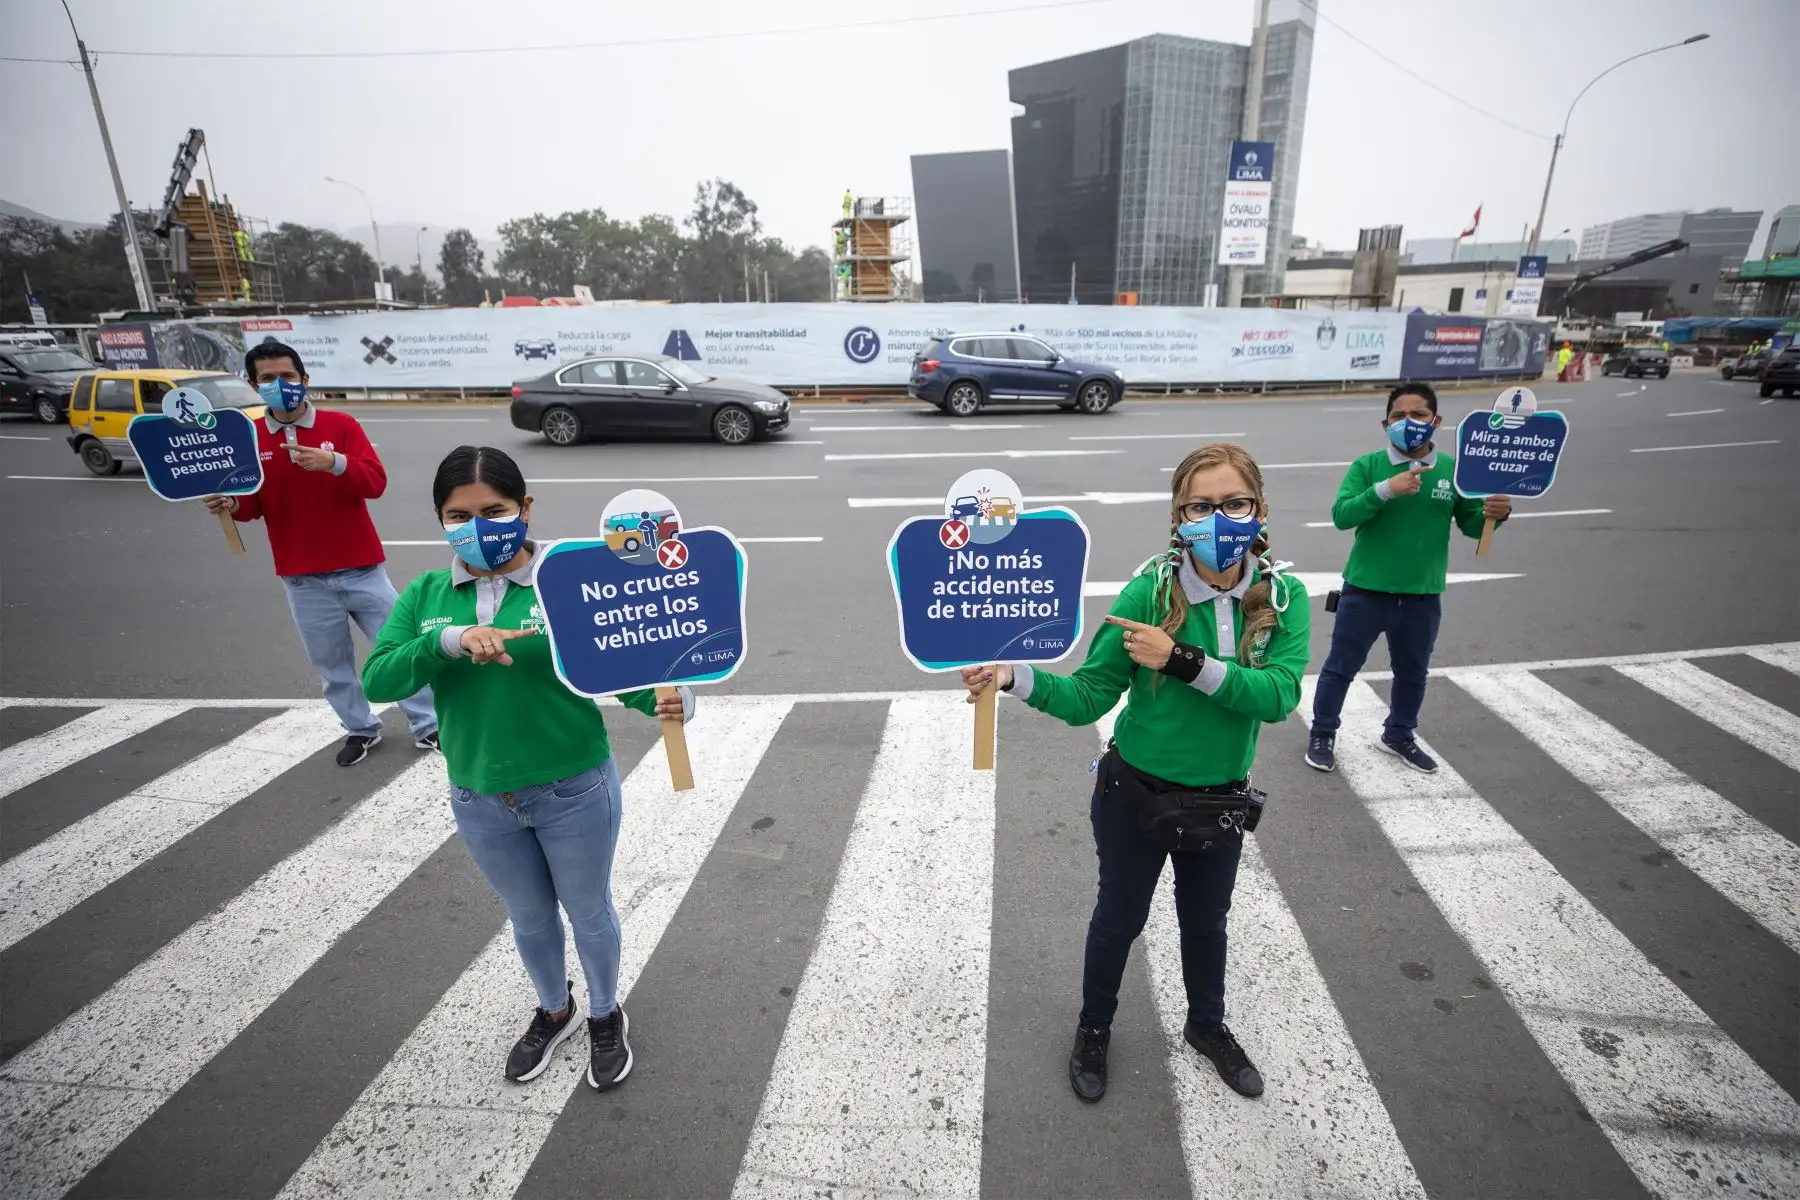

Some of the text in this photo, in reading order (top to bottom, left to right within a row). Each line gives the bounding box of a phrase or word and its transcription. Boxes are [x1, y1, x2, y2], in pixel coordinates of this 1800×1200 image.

[1236, 170, 1263, 180] LIMA
[1224, 218, 1268, 228] MONITOR
[427, 333, 437, 342] de
[557, 330, 595, 340] Reducirá
[606, 332, 631, 340] carga
[705, 328, 807, 340] Mejor transitabilidad
[888, 328, 920, 337] Ahorro
[922, 328, 935, 337] de
[1045, 328, 1063, 338] Más
[1066, 329, 1076, 338] de
[1078, 330, 1094, 338] 500
[1096, 328, 1109, 337] mil
[1112, 329, 1142, 338] vecinos
[1144, 329, 1154, 338] de
[734, 342, 776, 352] avenidas
[1083, 342, 1094, 350] de
[1096, 342, 1118, 350] Surco
[1345, 332, 1386, 350] LIMA
[120, 348, 148, 360] MONITOR
[559, 344, 612, 352] vehicular del
[1123, 354, 1138, 362] San
[168, 432, 218, 448] Utiliza
[1470, 430, 1556, 448] Mira a ambos
[164, 445, 234, 464] el crucero
[1464, 444, 1555, 462] lados antes de
[170, 456, 236, 480] peatonal
[1488, 462, 1529, 473] cruzar
[948, 549, 1043, 574] ¡No más
[581, 570, 700, 602] No cruces
[932, 575, 1054, 596] accidentes
[594, 595, 699, 626] entre los
[928, 598, 1060, 618] de tránsito!
[420, 616, 452, 627] MOVILIDAD
[594, 618, 708, 650] vehículos
[1038, 640, 1064, 649] LIMA
[708, 650, 735, 663] LIMA
